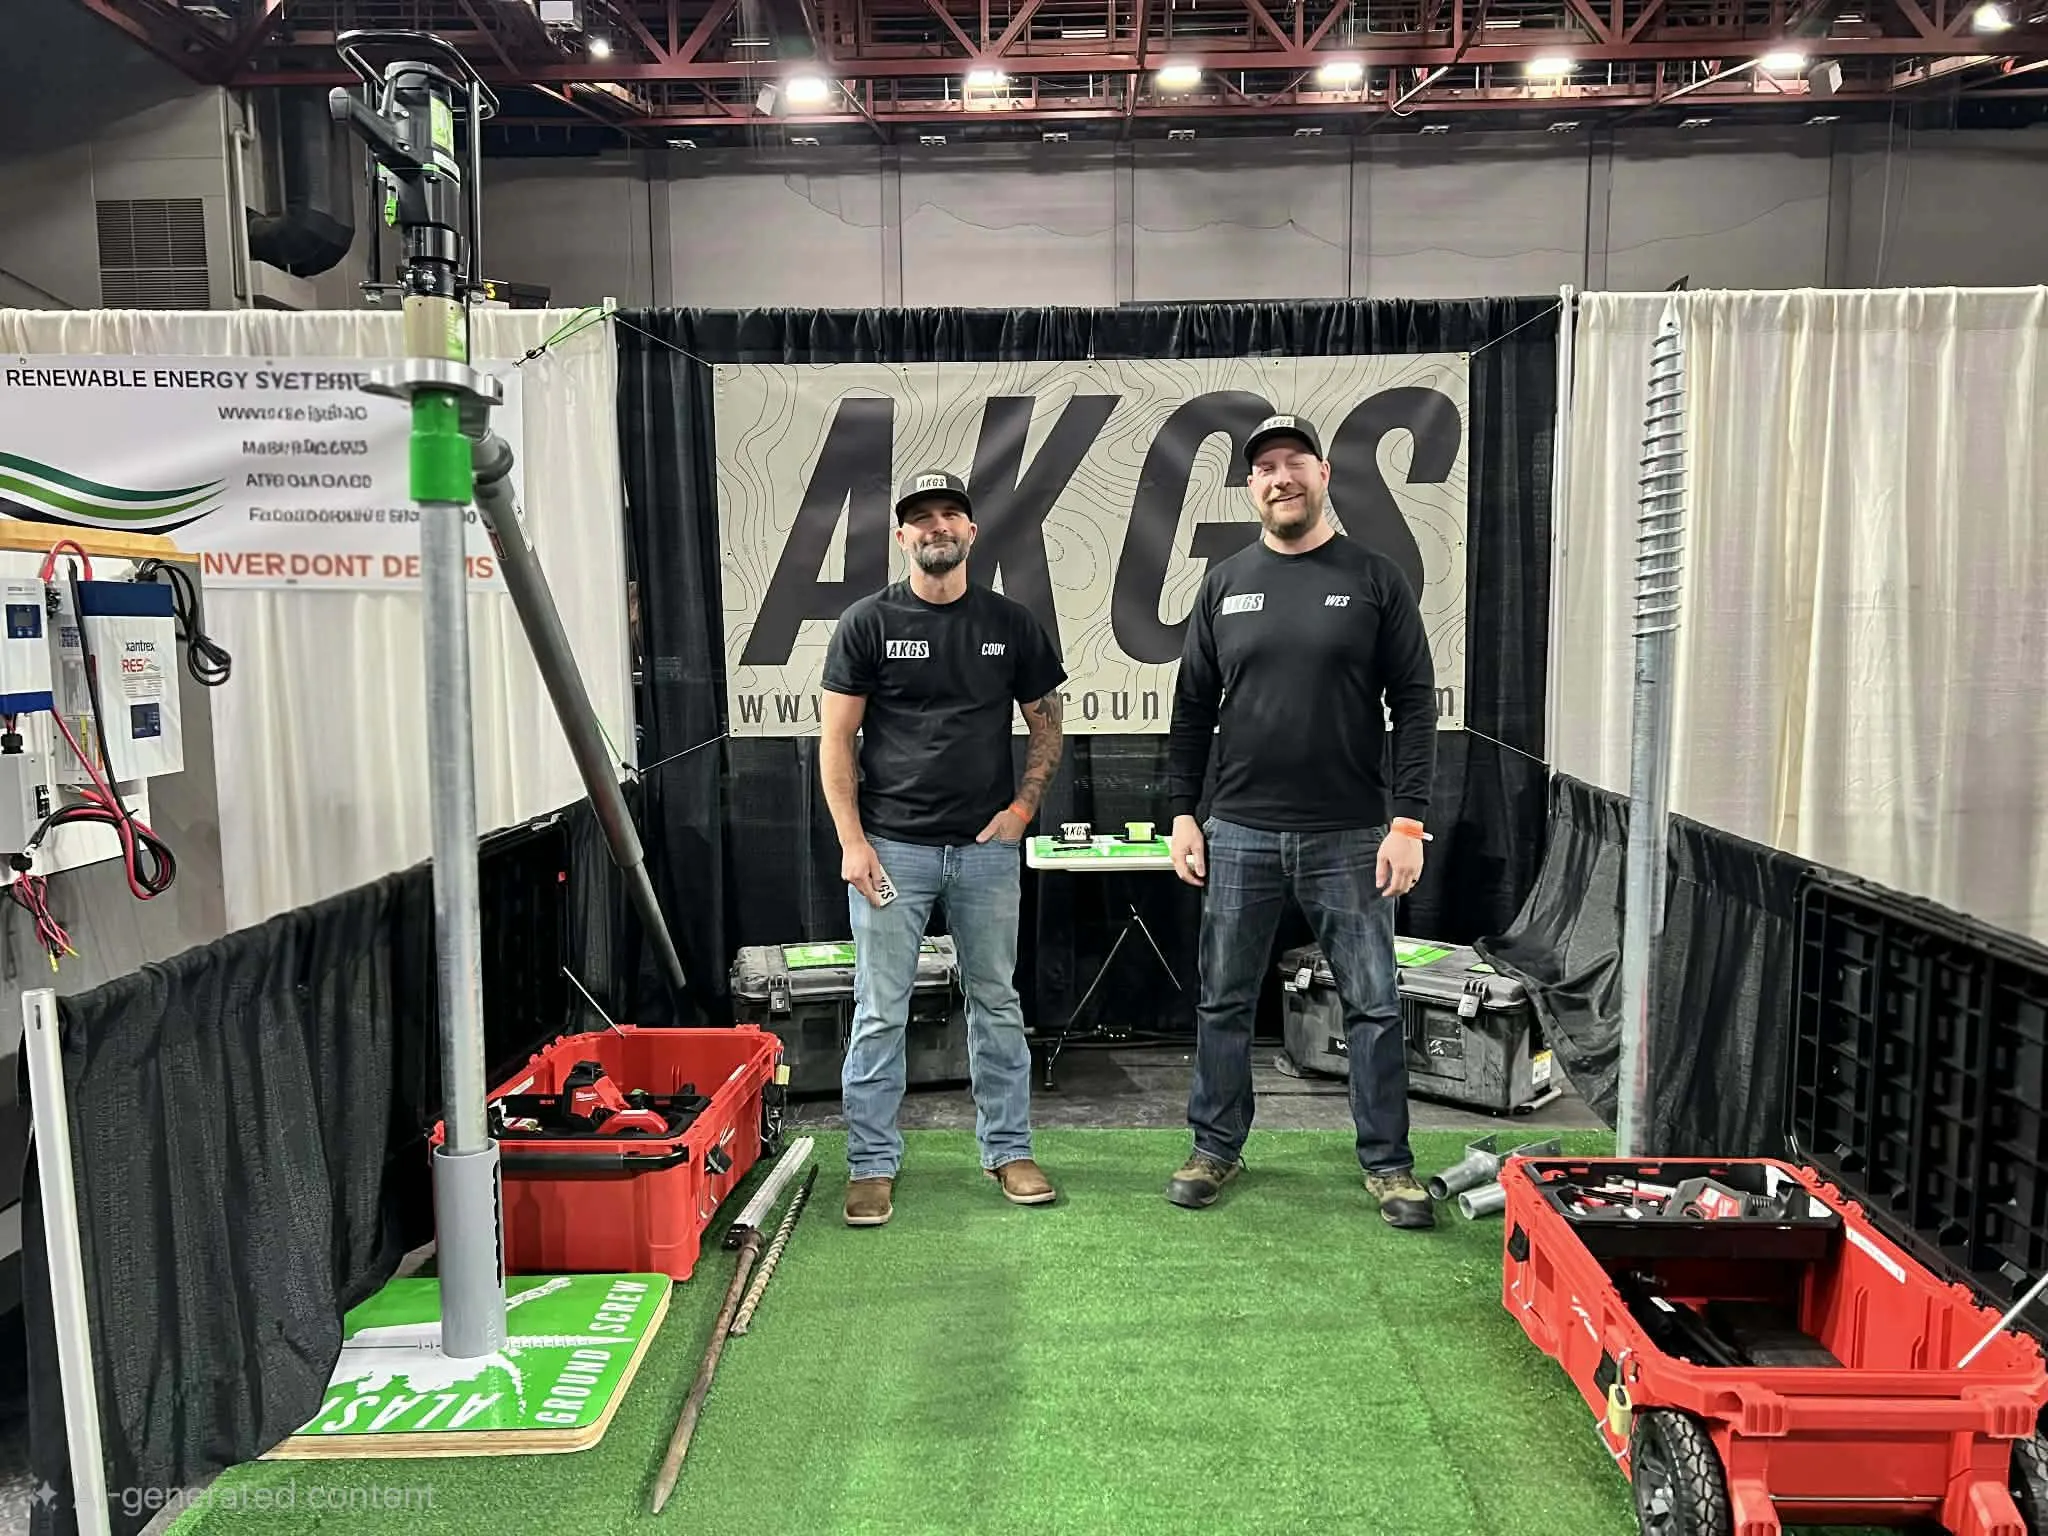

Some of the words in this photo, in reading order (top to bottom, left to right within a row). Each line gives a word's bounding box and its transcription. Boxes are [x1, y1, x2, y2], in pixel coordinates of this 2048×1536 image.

[6, 369, 147, 387] RENEWABLE
[154, 371, 248, 389] ENERGY
[919, 478, 945, 488] AKGS
[739, 387, 1462, 666] AKGS
[1325, 595, 1350, 607] WES
[125, 640, 155, 651] xantrex
[888, 642, 927, 657] AKGS
[981, 643, 1006, 656] CODY
[536, 1349, 611, 1423] GROUND
[589, 1280, 649, 1334] SCREW
